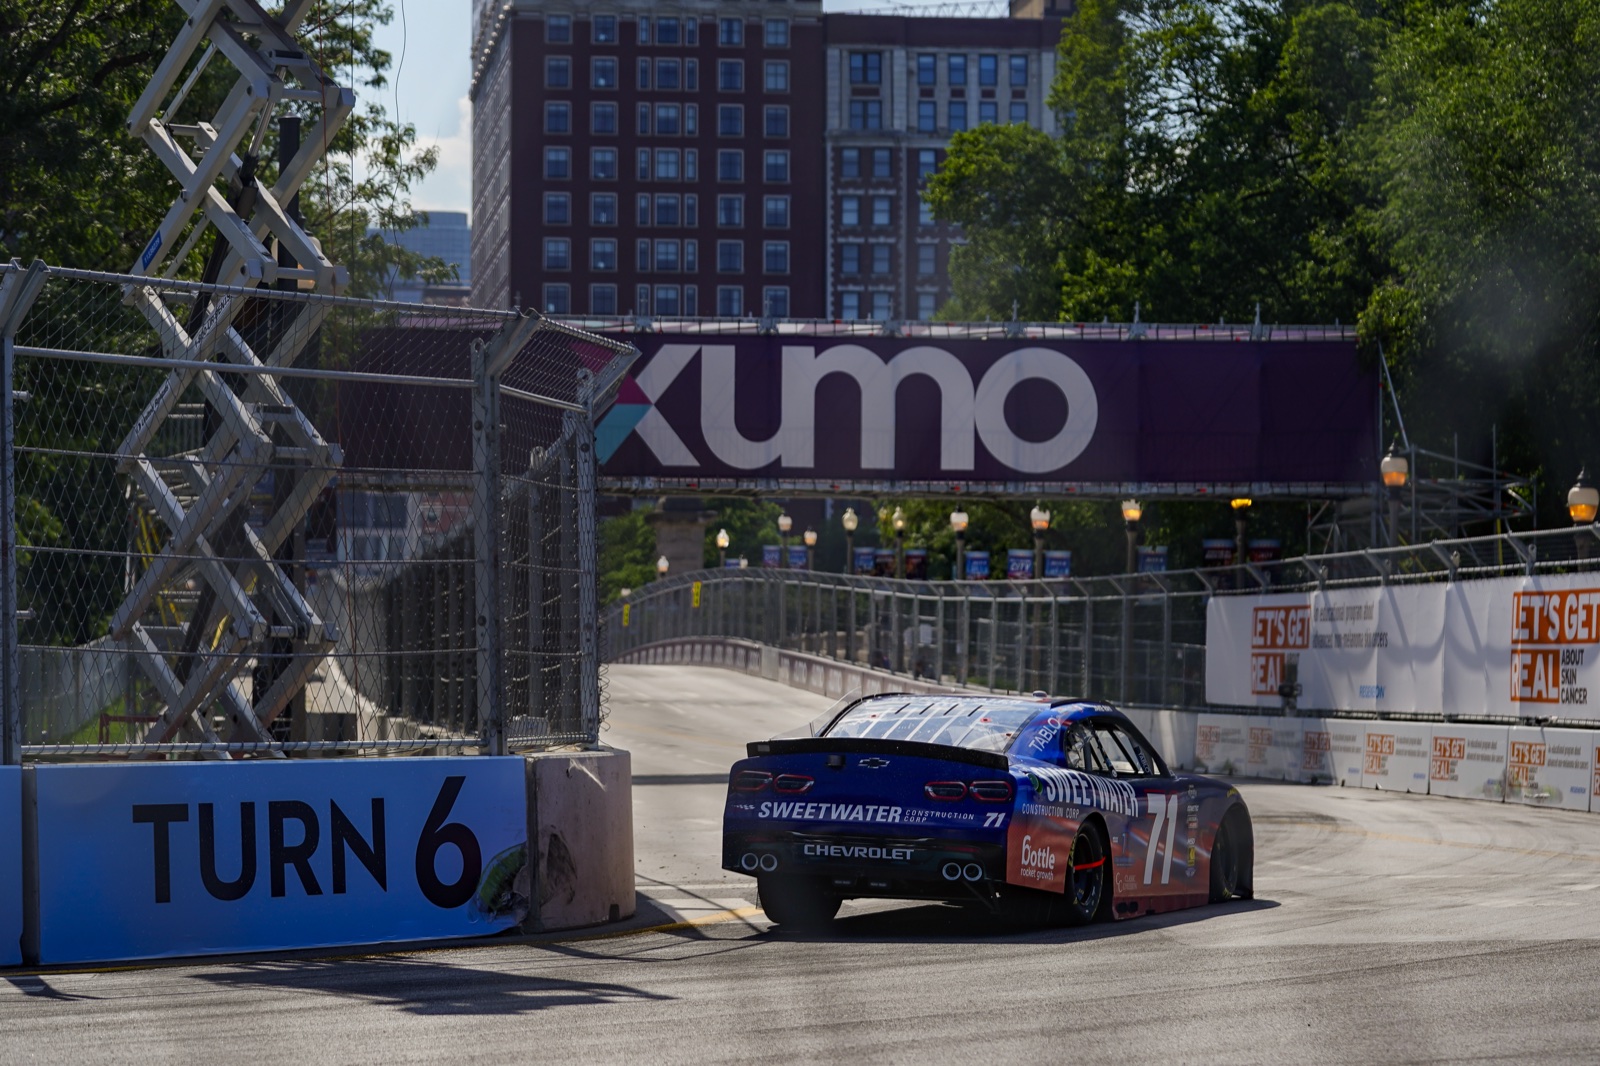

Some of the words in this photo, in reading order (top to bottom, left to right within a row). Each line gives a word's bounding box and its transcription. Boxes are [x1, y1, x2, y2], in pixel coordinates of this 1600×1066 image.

[1513, 592, 1561, 641] LET'S
[1564, 591, 1600, 641] GET
[1288, 608, 1310, 646] GET
[1561, 649, 1584, 666] ABOUT
[1511, 652, 1559, 700] REAL
[1561, 668, 1577, 685] SKIN
[1561, 687, 1587, 705] CANCER
[1029, 716, 1062, 752] TABLO
[1433, 738, 1451, 759] LET'S
[1451, 739, 1465, 760] GET
[1511, 742, 1529, 764] LET'S
[1530, 744, 1546, 766] GET
[1431, 760, 1450, 779] REAL
[1031, 766, 1139, 818] SWEETWATER
[758, 801, 903, 823] SWEETWATER
[903, 815, 928, 823] CORP
[905, 809, 975, 820] CONSTRUCTION
[982, 812, 1006, 828] 71
[1021, 803, 1064, 818] CONSTRUCTION
[1065, 807, 1080, 819] CORP
[132, 797, 388, 904] TURN
[415, 775, 482, 909] 6
[1142, 792, 1179, 885] 71
[803, 844, 915, 860] CHEVROLET
[1020, 867, 1036, 878] rocket
[1036, 870, 1054, 881] growth
